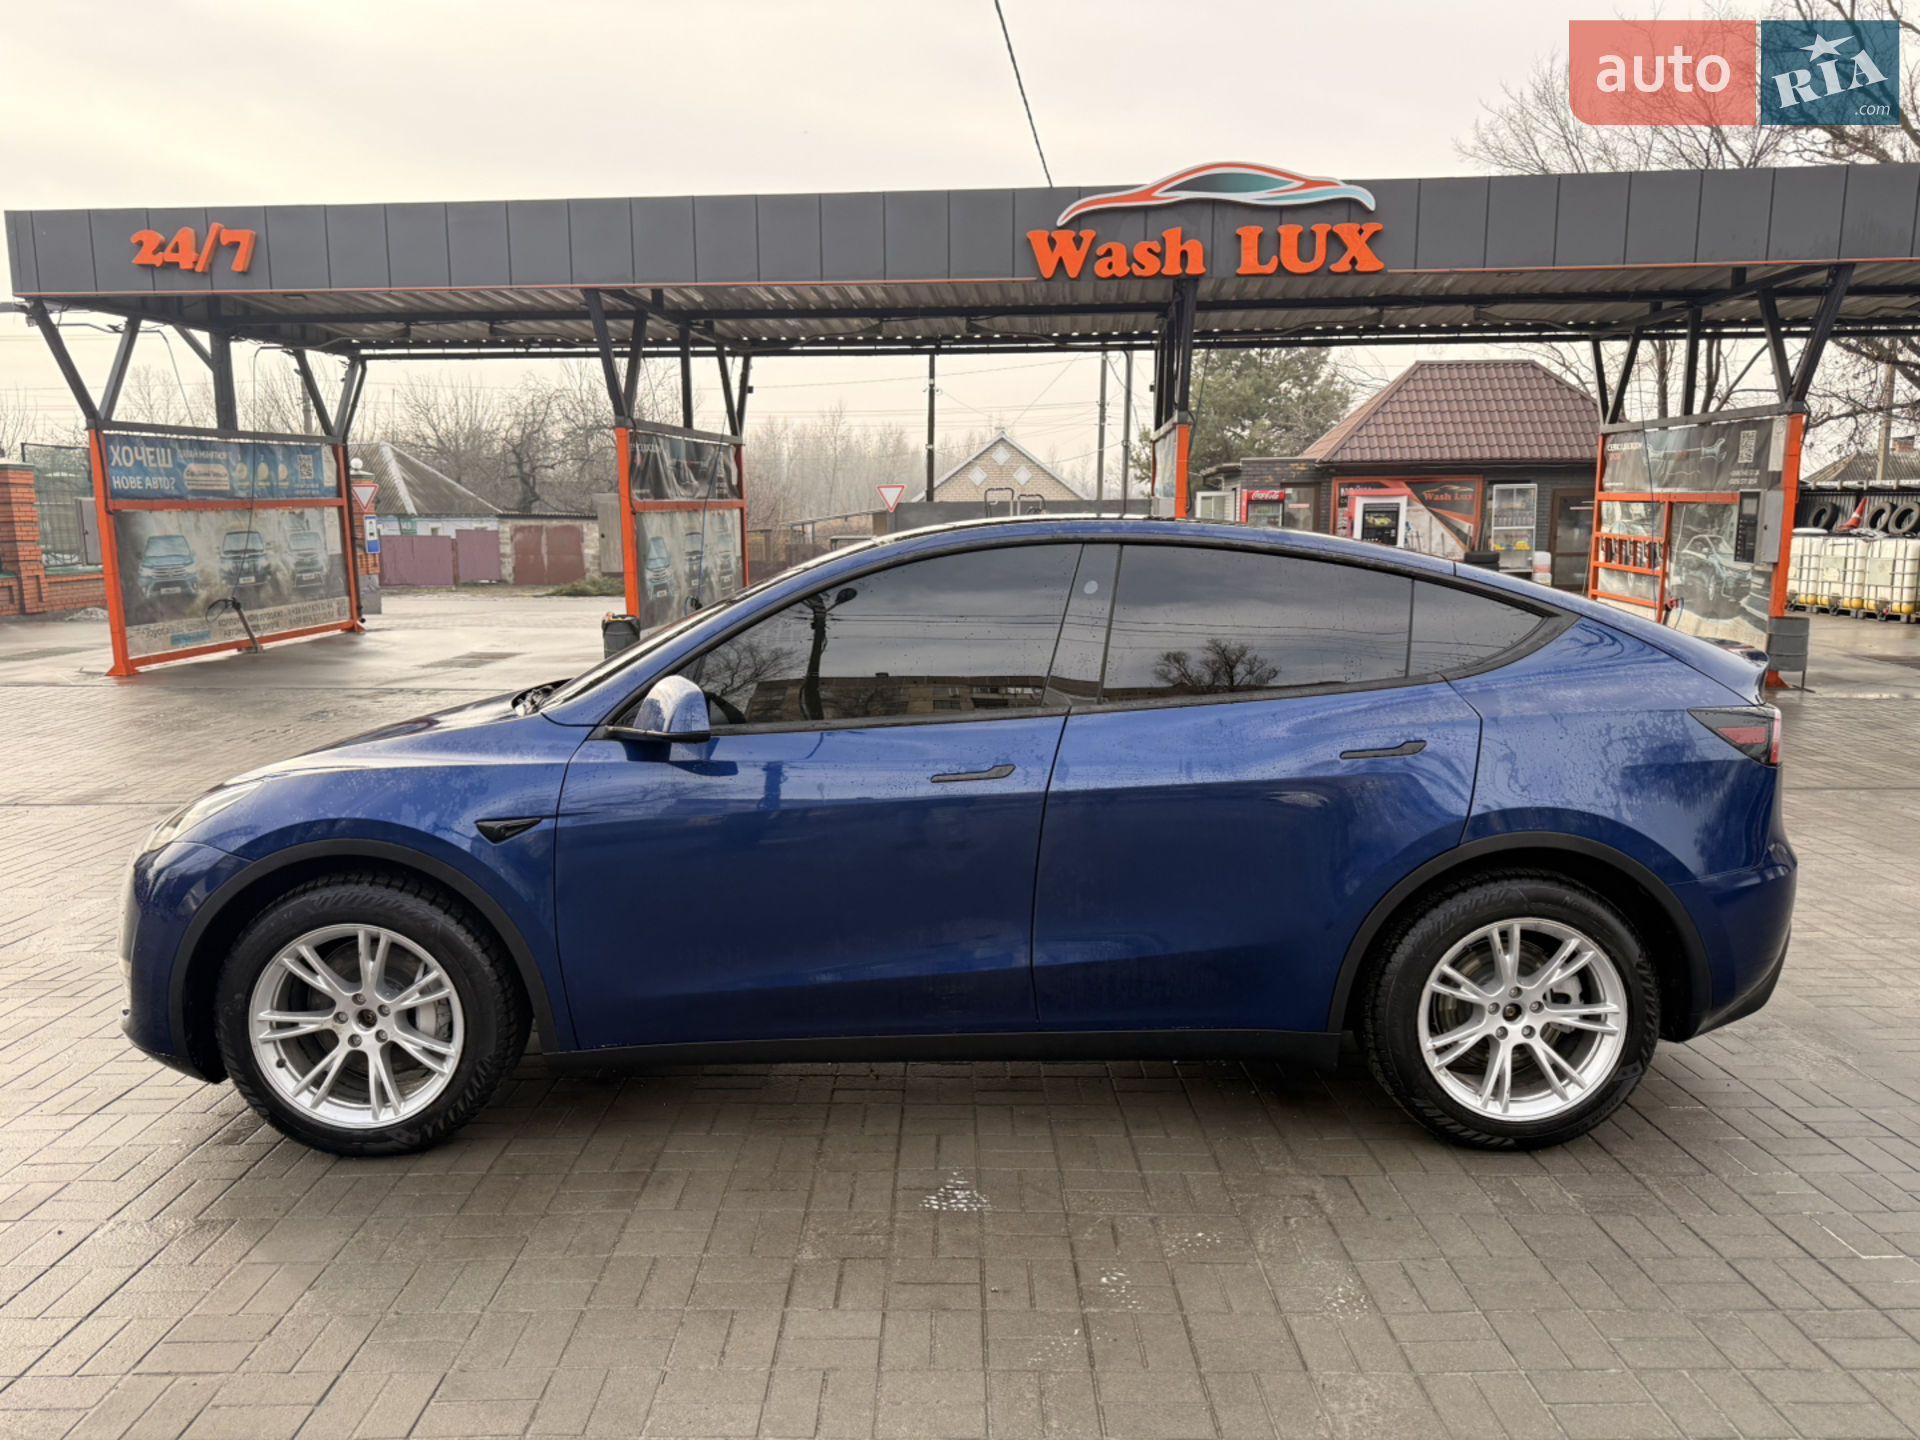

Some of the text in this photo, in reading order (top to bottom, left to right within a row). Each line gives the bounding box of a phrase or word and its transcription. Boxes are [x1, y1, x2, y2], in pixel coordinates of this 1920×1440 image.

[130, 222, 257, 273] 24/7
[1026, 223, 1385, 279] Wash LUX
[110, 445, 174, 468] ХОЧЕШ
[112, 475, 177, 490] НОВЕ АВТО?
[1424, 492, 1452, 501] Wash
